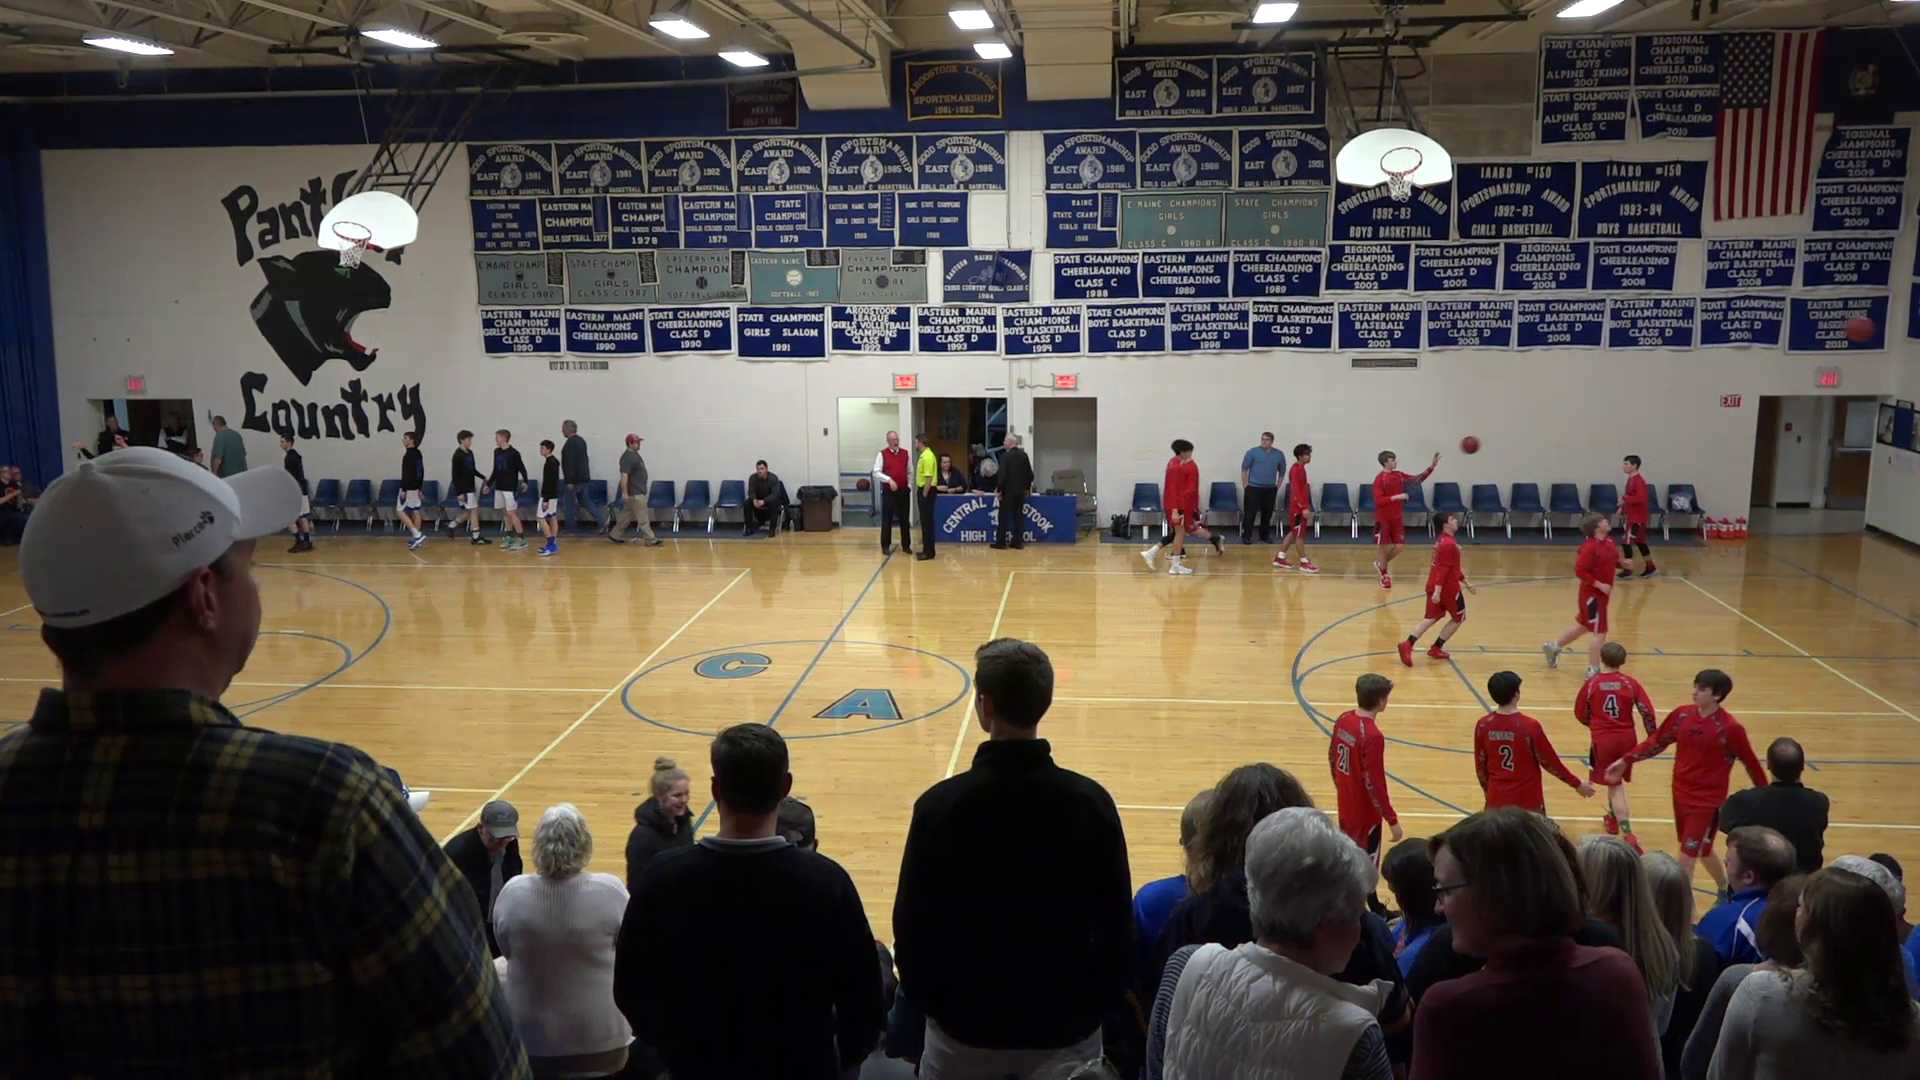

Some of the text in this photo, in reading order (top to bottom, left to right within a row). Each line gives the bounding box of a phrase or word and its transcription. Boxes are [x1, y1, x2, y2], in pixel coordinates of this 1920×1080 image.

[1545, 40, 1573, 49] STATE
[1566, 50, 1611, 59] CLASS C
[1576, 60, 1600, 68] BOYS
[1592, 68, 1629, 77] SKIING
[1574, 78, 1599, 86] 2007
[1242, 130, 1327, 154] GOOD SPORTSMANSHIP
[1272, 139, 1298, 147] AWARD
[737, 138, 822, 171] GOOD SPORTSMANSHIP
[763, 150, 794, 158] AWARD
[828, 138, 912, 174] GOOD SPORTSMANSHIP
[1245, 161, 1265, 169] EAST
[744, 167, 768, 175] EAST
[836, 166, 859, 174] EAST
[1481, 167, 1512, 179] IAABO
[1607, 165, 1641, 177] IAABO
[1584, 180, 1699, 212] SPORTSMANSHIP AWARD
[1138, 200, 1162, 208] MAINE
[1170, 199, 1216, 207] CHAMPIONS
[1235, 199, 1259, 207] STATE
[1541, 188, 1570, 213] AWARD
[1159, 212, 1184, 220] GIRLS
[1471, 224, 1552, 236] GIRLS BASKETBALL
[1597, 223, 1682, 234] BOYS BASKETBALL
[1128, 240, 1156, 248] CLASS
[1345, 245, 1393, 254] REGIONAL
[1594, 244, 1677, 254] STATE CHAMPIONS
[1055, 255, 1138, 264] STATE CHAMPIONS
[1145, 254, 1228, 263] EASTERN MAINE
[1234, 254, 1321, 262] STATE CHAMPIONS
[1342, 255, 1395, 263] CHAMPION
[1600, 257, 1670, 265] CHEERLEADING
[1158, 265, 1214, 273] CHAMPIONS
[1241, 264, 1313, 272] CHEERLEADING
[1331, 263, 1405, 271] CHEERLEADING
[1061, 267, 1131, 276] CHEERLEADING
[1613, 267, 1655, 276] CLASS D
[1150, 276, 1221, 284] CHEERLEADING
[1254, 274, 1285, 282] CLASS
[1346, 272, 1388, 280] CLASS D
[1074, 279, 1103, 287] CLASS
[1175, 286, 1196, 295] 1989
[1265, 285, 1287, 293] 1989
[1086, 290, 1108, 298] 1988
[1339, 303, 1422, 312] EASTERN MAINE
[1610, 300, 1653, 308] EASTERN
[845, 306, 897, 315] AROOSTOOK
[918, 308, 996, 317] EASTERN MAINE
[1253, 305, 1333, 313] STATE CHAMPIONS
[1621, 309, 1683, 317] CHAMPIONS
[566, 312, 644, 321] EASTERN MAINE
[649, 310, 730, 320] STATE CHAMPIONS
[738, 313, 824, 322] STATE CHAMPIONS
[1253, 314, 1333, 323] BOYS BASKETBALL
[1350, 313, 1410, 321] CHAMPIONS
[657, 320, 722, 328] CHEERLEADING
[929, 317, 984, 325] CHAMPIONS
[1355, 321, 1404, 329] BASEBALL
[1610, 319, 1694, 328] BOYS BASKETBALL
[579, 323, 631, 331] CHAMPIONS
[832, 321, 910, 330] GIRLS VOLLEYBALL
[944, 325, 997, 333] BASKETBALL
[670, 330, 710, 338] CLASS D
[744, 328, 818, 336] GIRLS SLALOM
[845, 329, 897, 337] CHAMPIONS
[1271, 326, 1313, 334] CLASS D
[1358, 330, 1388, 338] CLASS
[1629, 328, 1672, 337] CLASS D
[572, 332, 638, 340] CHEERLEADING
[852, 336, 879, 344] CLASS
[936, 335, 964, 343] CLASS
[1281, 336, 1301, 344] 1996
[681, 340, 701, 348] 1990
[772, 343, 790, 351] 1991
[240, 371, 426, 448] Country
[943, 497, 1054, 533] CENTRAL ASTOOK
[960, 531, 986, 541] HIGH
[694, 652, 772, 679] C
[812, 689, 903, 719] A
[1603, 695, 1618, 718] 4
[1338, 744, 1350, 775] 21
[1500, 745, 1514, 771] 2
